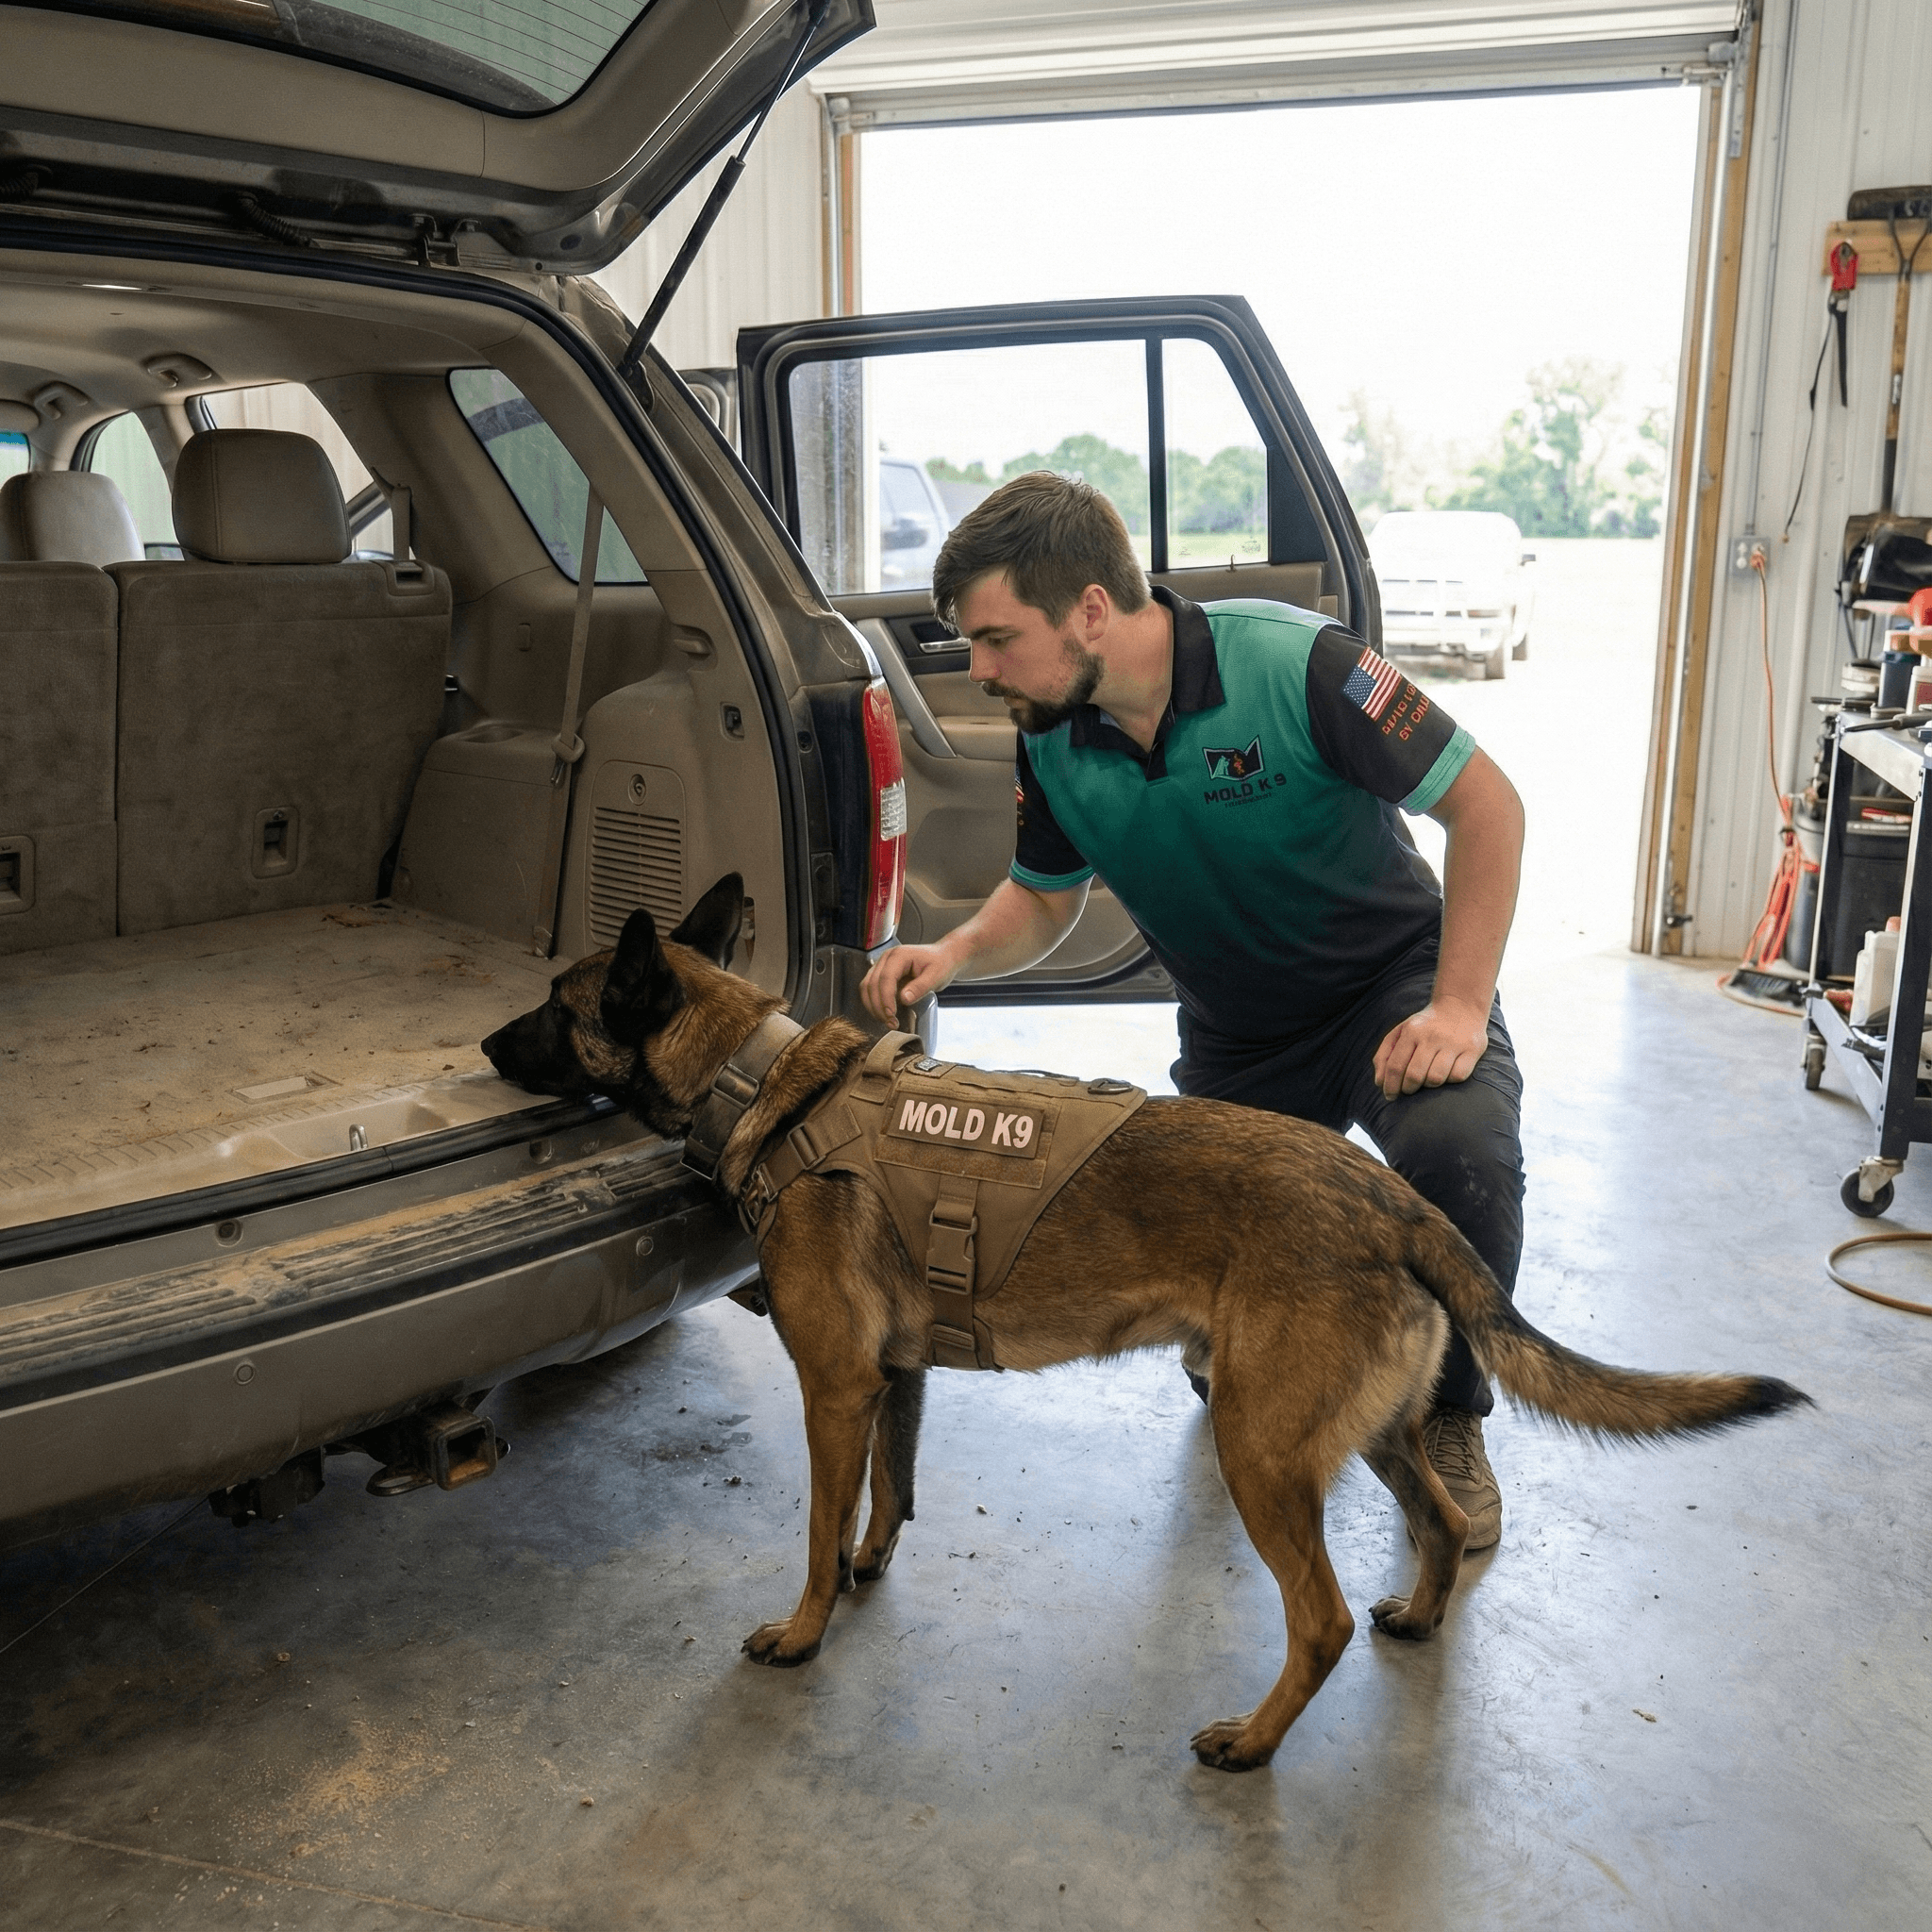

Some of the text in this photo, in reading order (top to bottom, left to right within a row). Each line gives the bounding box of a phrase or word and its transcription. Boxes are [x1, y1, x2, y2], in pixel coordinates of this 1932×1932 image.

[1204, 783, 1254, 804] MOLD
[899, 1099, 1034, 1149] MOLD K9
